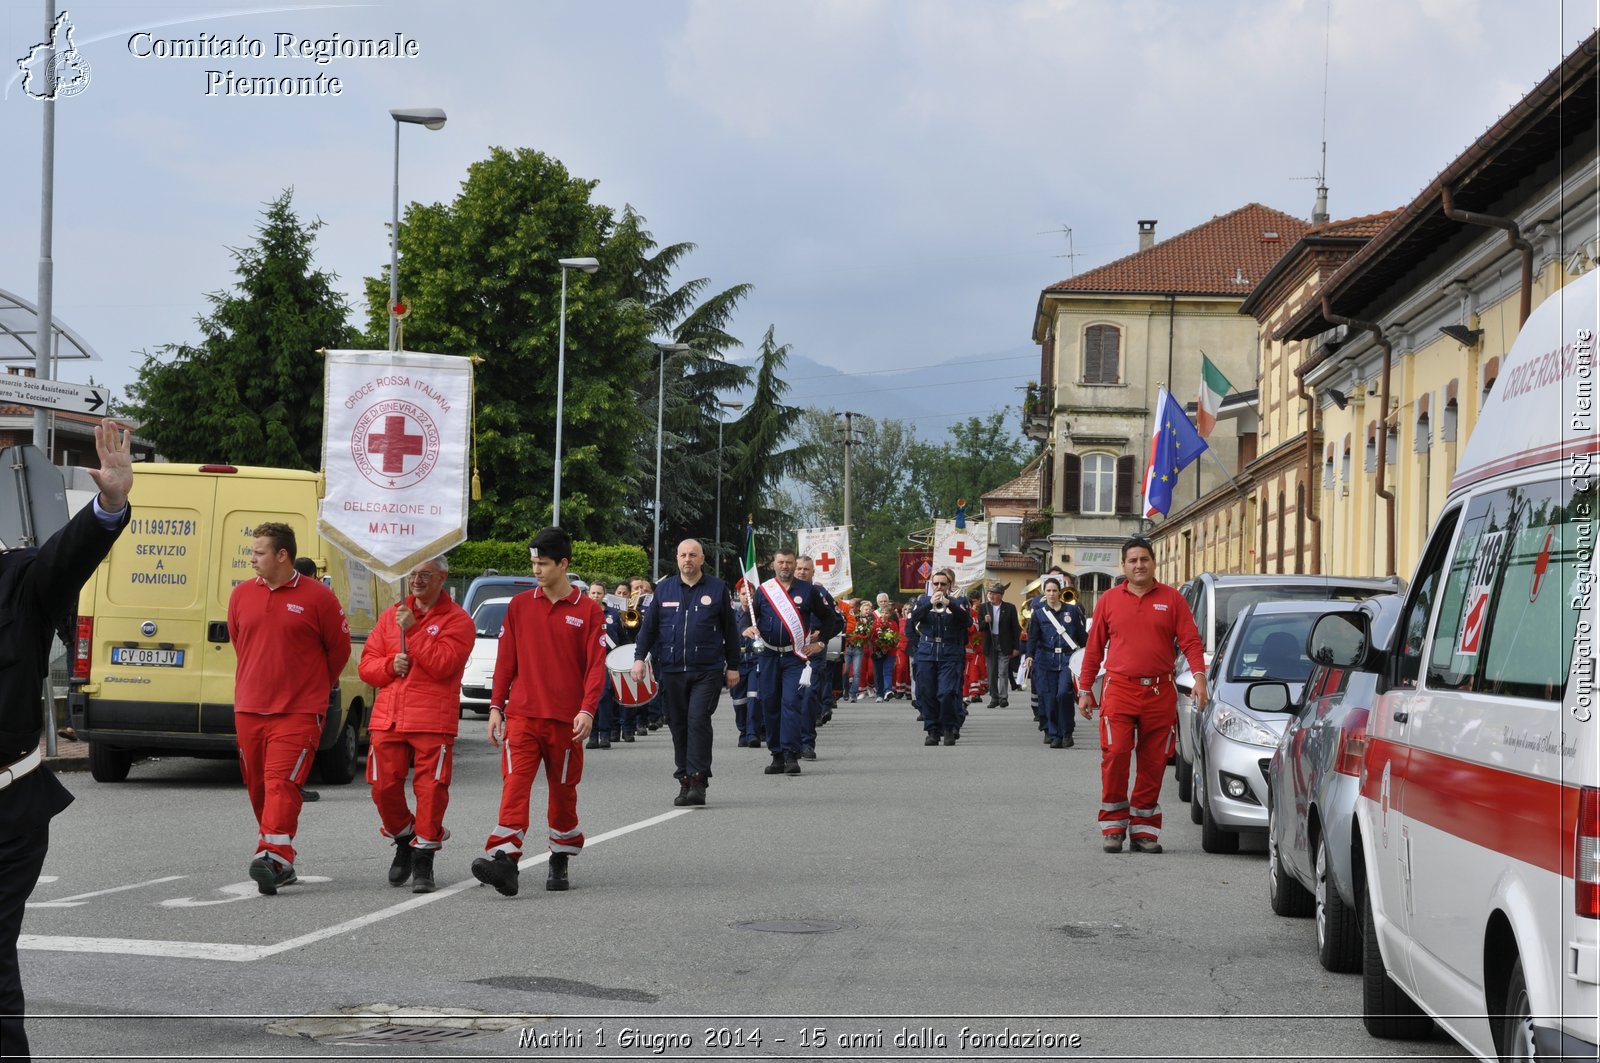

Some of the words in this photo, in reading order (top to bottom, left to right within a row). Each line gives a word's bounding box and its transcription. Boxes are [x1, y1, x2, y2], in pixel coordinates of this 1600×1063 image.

[1502, 357, 1541, 402] CROCE
[24, 381, 40, 390] Socio
[41, 384, 79, 396] Assistenziale
[344, 382, 375, 410] CROCE
[376, 376, 410, 387] ROSSA
[414, 379, 451, 414] ITALIANA
[370, 408, 379, 417] DI
[379, 402, 416, 416] GINEVRA
[416, 412, 428, 424] 22
[353, 414, 373, 476] CONVENZIONE
[425, 424, 438, 461] AGOSTO
[415, 461, 432, 478] 1864
[344, 501, 425, 514] DELEGAZIONE
[430, 505, 442, 515] DI
[368, 522, 415, 535] MATHI
[136, 544, 187, 556] SERVIZIO
[155, 559, 164, 570] A
[1475, 533, 1503, 586] 118
[131, 572, 187, 585] DOMICILIO
[120, 650, 135, 662] CV
[138, 651, 176, 663] 081JV
